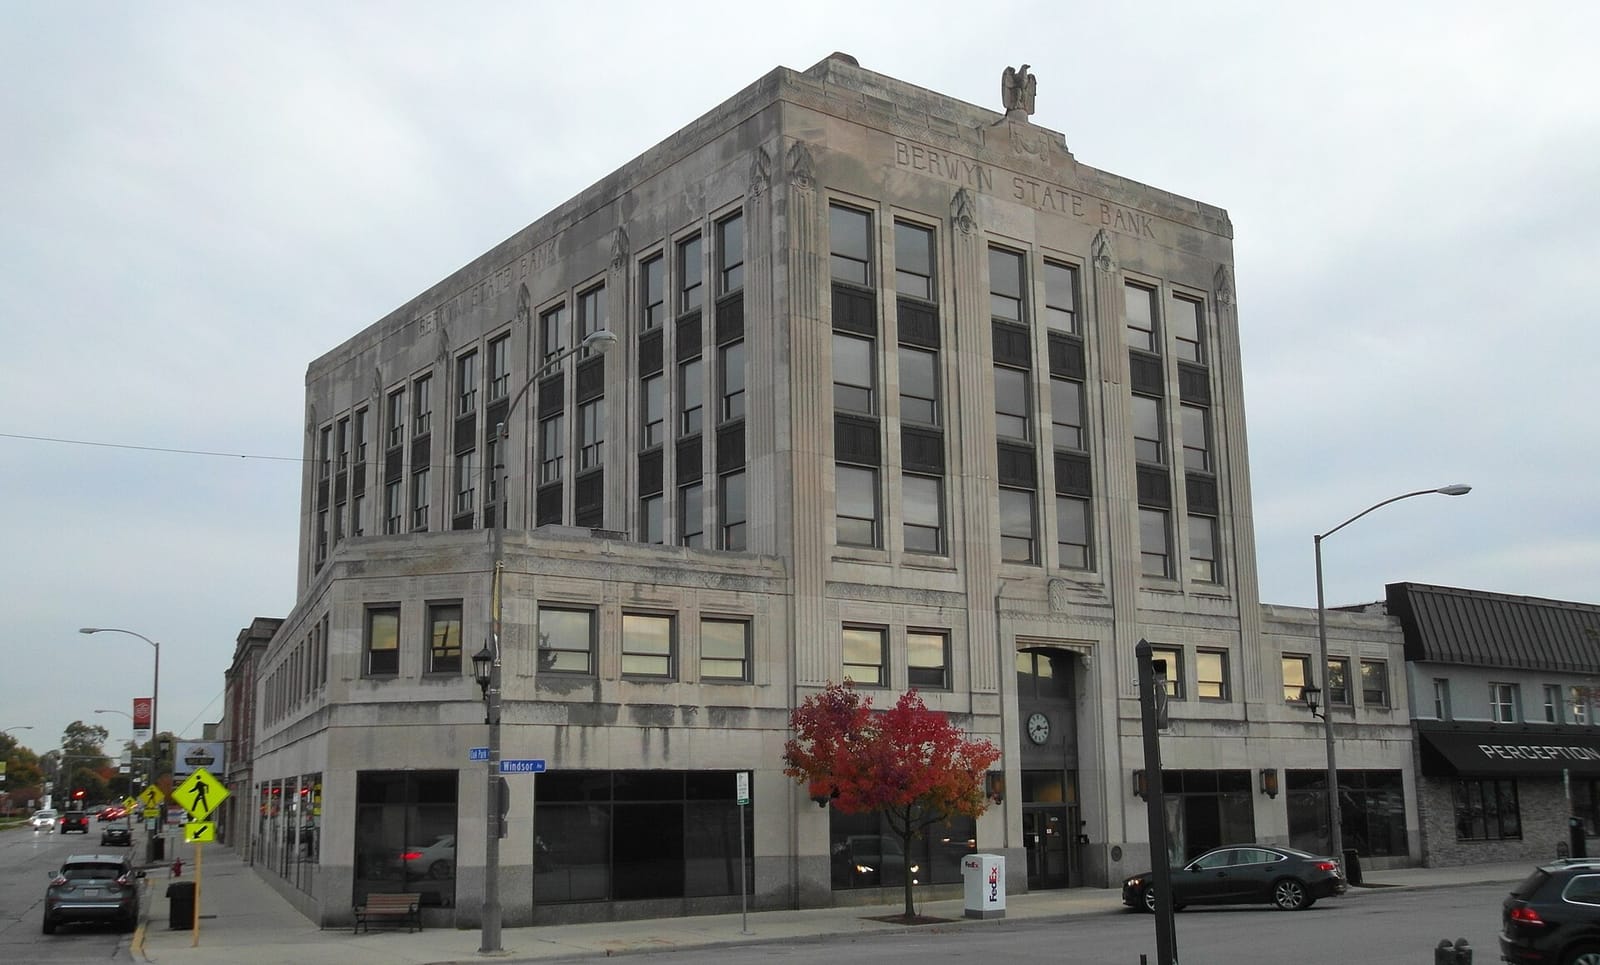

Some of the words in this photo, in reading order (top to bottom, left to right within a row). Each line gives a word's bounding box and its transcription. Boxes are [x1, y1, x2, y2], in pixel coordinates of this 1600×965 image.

[896, 140, 992, 191] BERWYN
[1013, 177, 1085, 218] STATE
[1101, 201, 1155, 239] BANK
[1478, 744, 1600, 760] PERCEPTION
[503, 761, 534, 771] Windsor
[989, 867, 997, 902] FedEx
